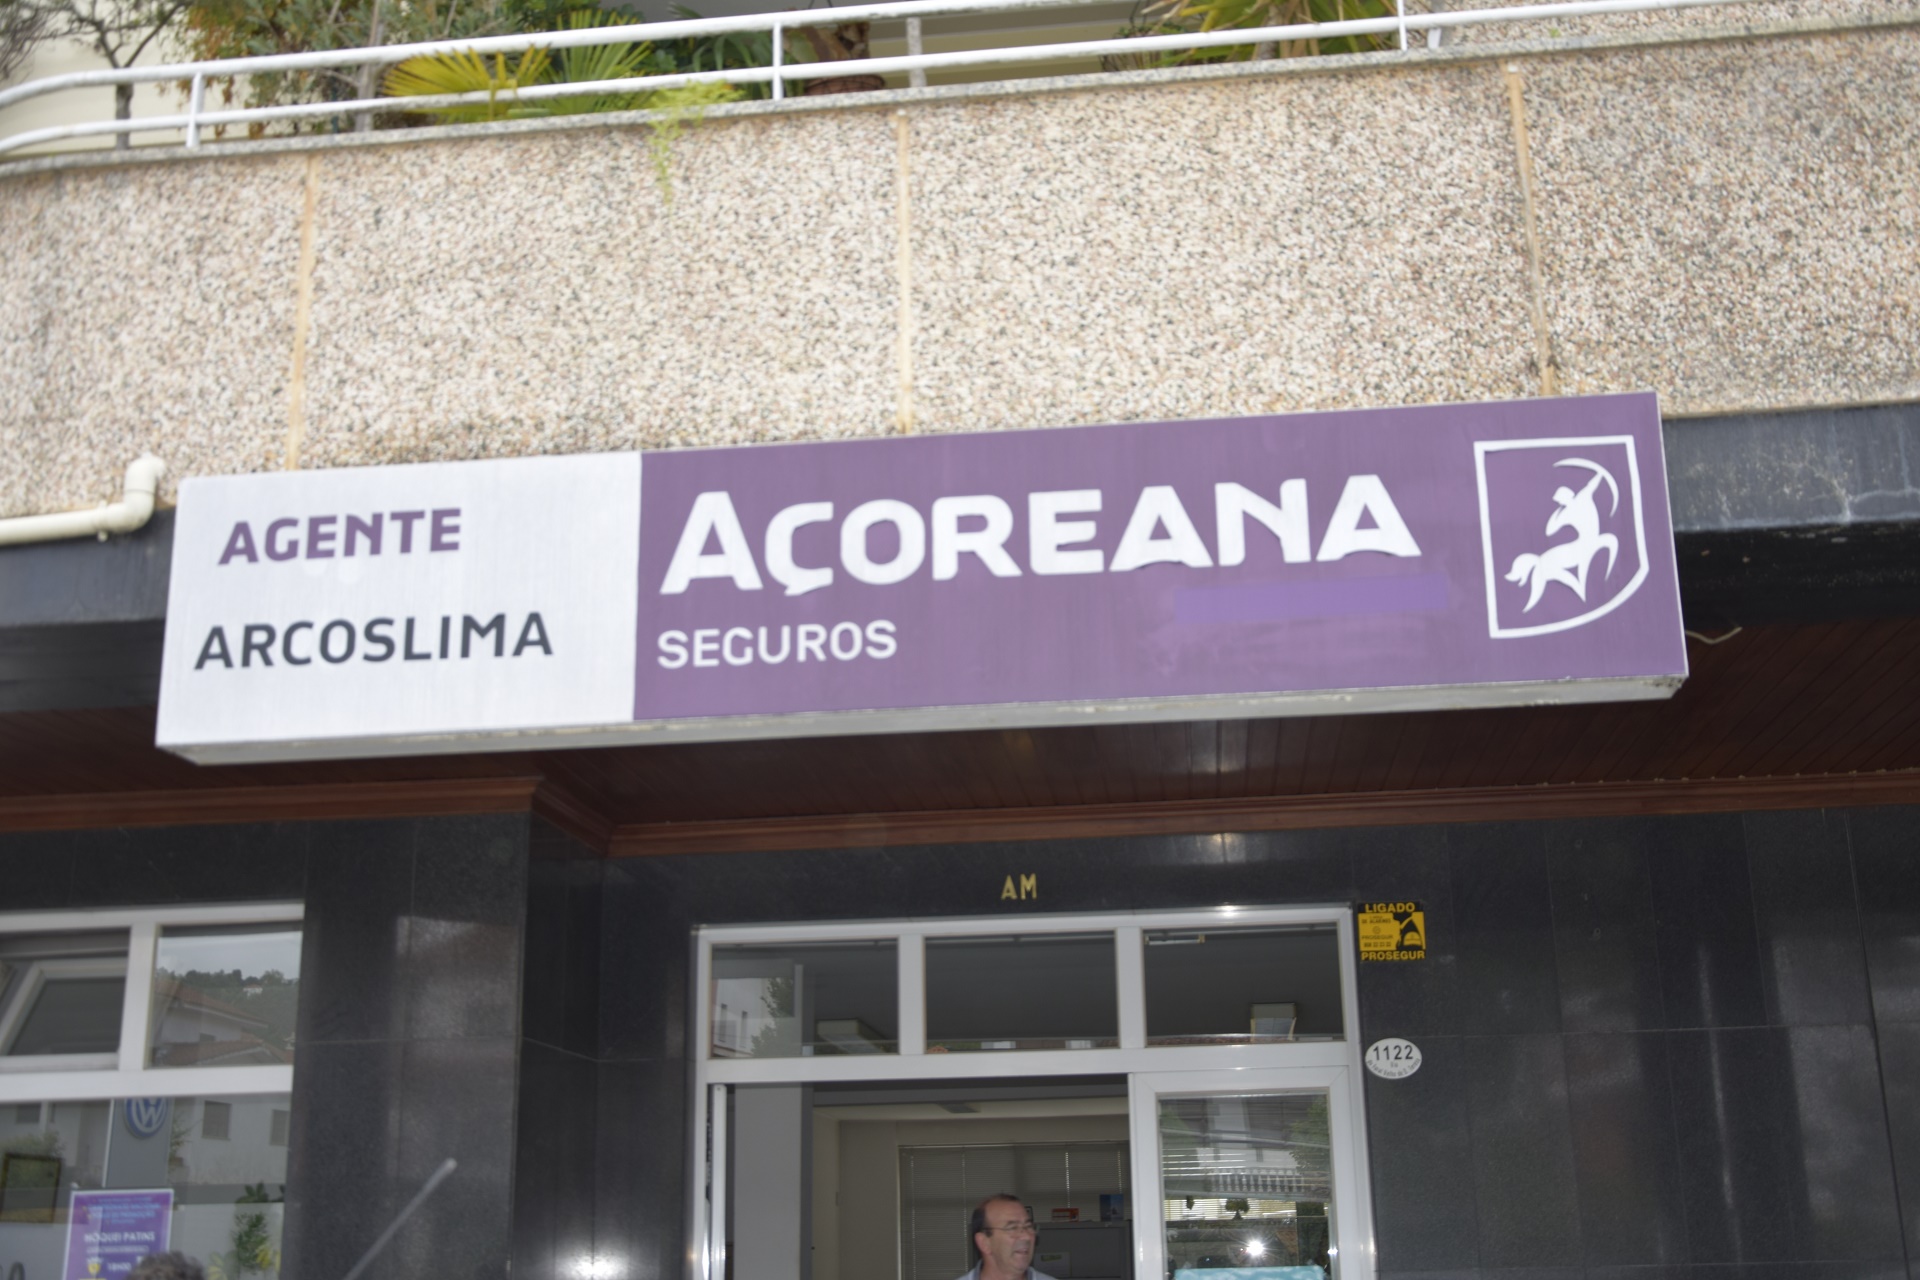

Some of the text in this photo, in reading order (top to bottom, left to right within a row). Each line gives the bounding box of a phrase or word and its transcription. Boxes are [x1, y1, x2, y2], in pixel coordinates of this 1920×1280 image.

[218, 508, 462, 566] AGENTE
[660, 474, 1422, 597] AÇOREANA
[194, 612, 553, 670] ARCOSLIMA
[657, 619, 898, 669] SEGUROS
[1001, 873, 1037, 900] AM
[1364, 902, 1415, 913] LIGADO
[1361, 950, 1425, 961] PROSEGUR
[1373, 1044, 1413, 1060] 1122
[123, 1231, 155, 1242] PATINS
